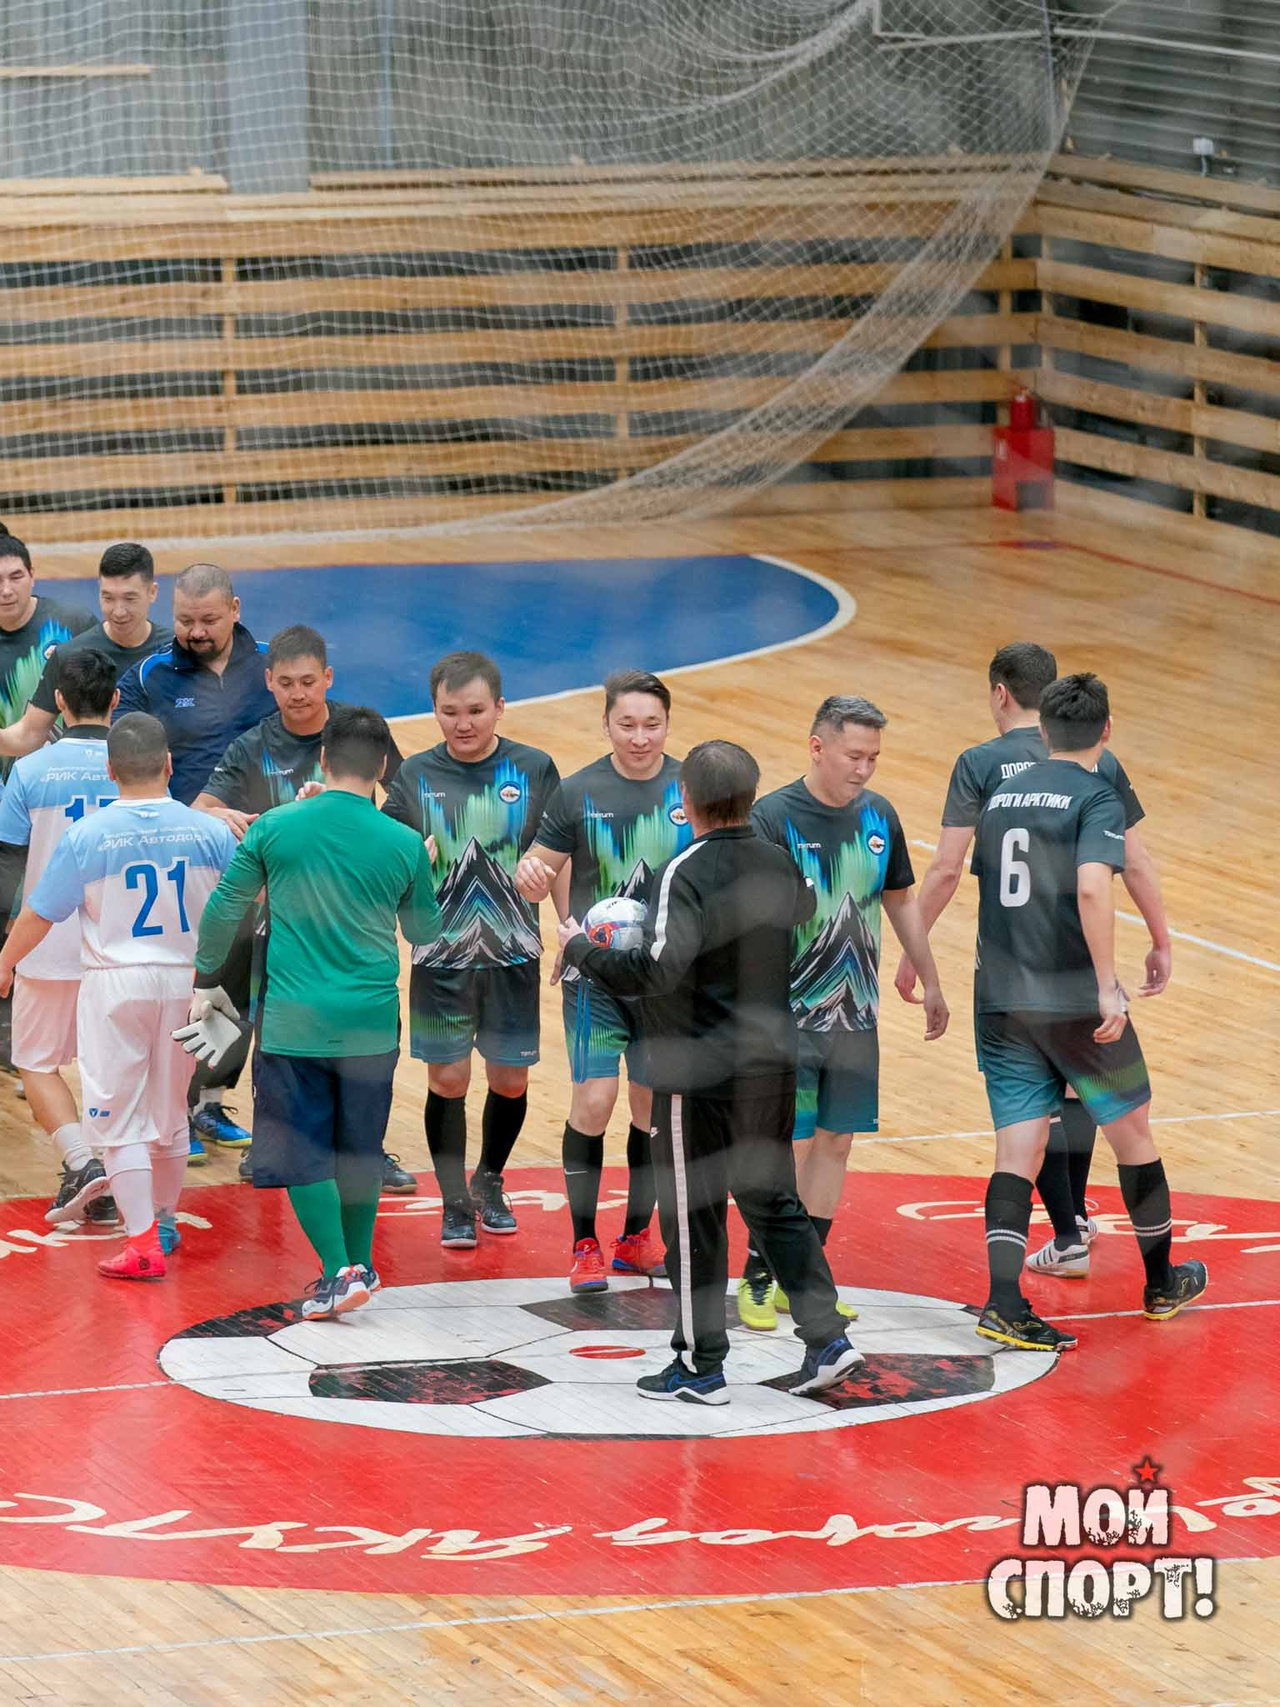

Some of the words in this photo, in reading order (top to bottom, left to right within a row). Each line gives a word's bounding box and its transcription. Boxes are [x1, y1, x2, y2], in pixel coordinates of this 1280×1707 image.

[987, 793, 1024, 812] ДОРОГИ
[1021, 792, 1073, 810] АРКТИКИ
[125, 859, 191, 938] 21
[1000, 828, 1032, 908] 6
